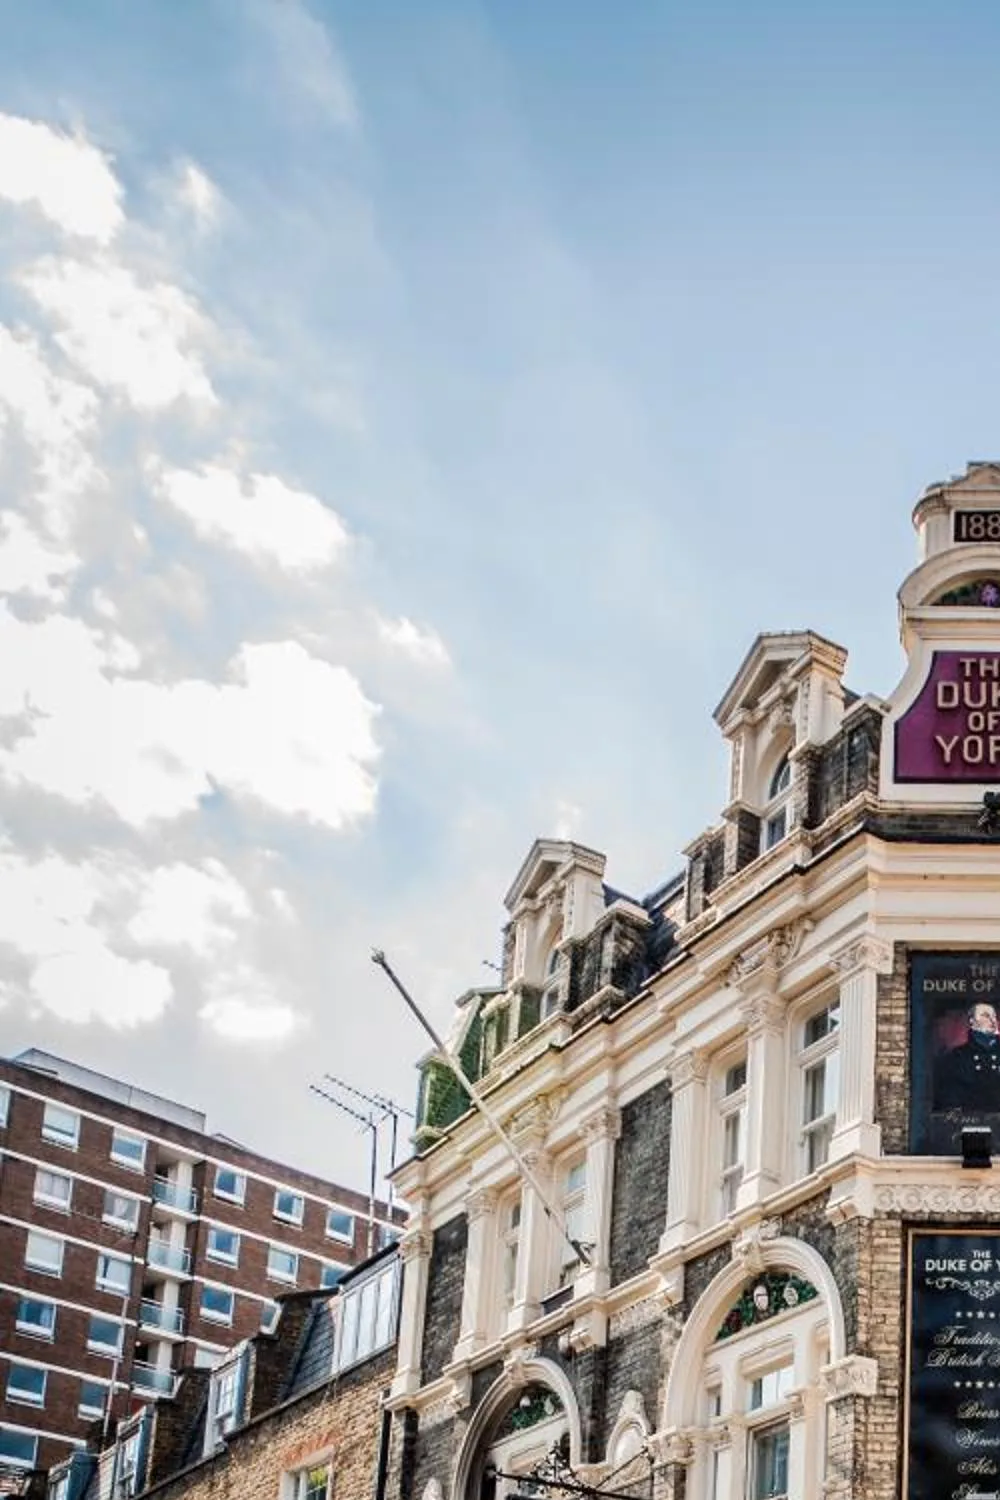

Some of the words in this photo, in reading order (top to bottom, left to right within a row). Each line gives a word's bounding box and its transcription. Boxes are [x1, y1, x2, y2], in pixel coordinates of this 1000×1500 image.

[969, 964, 999, 977] THE
[923, 979, 967, 993] DUKE
[972, 979, 994, 993] OF
[972, 1250, 991, 1259] THE
[925, 1259, 967, 1272] DUKE
[970, 1259, 993, 1272] OF
[925, 1348, 989, 1368] British
